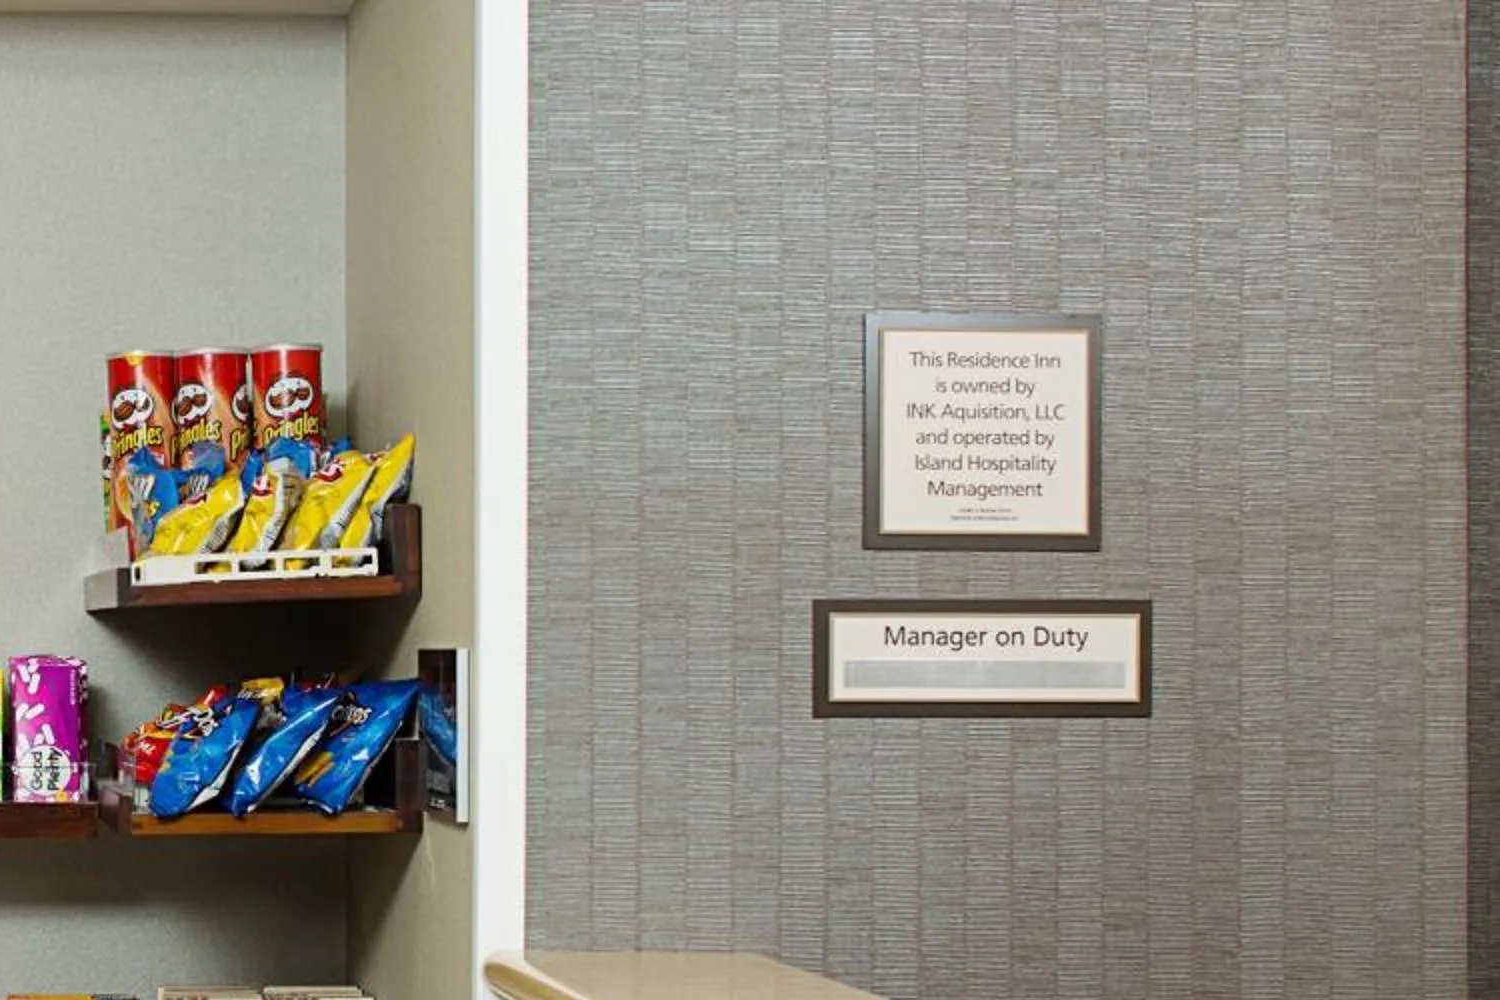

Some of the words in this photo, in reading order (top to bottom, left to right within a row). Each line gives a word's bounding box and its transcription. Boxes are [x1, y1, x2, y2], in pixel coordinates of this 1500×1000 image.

[909, 351, 943, 368] This
[947, 351, 1029, 368] Residence
[1034, 353, 1061, 369] Inn
[935, 378, 947, 394] is
[951, 378, 1011, 394] owned
[1015, 378, 1035, 398] by
[906, 403, 936, 420] INK
[941, 402, 1030, 423] Aquisition,
[1035, 403, 1066, 420] LLC
[915, 429, 948, 446] and
[953, 429, 1029, 449] operated
[1035, 430, 1055, 449] by
[915, 454, 962, 471] Island
[967, 454, 1057, 475] Hospitality
[927, 481, 1044, 500] Management
[883, 625, 988, 652] Manager
[995, 629, 1025, 647] on
[1033, 625, 1089, 652] Duty
